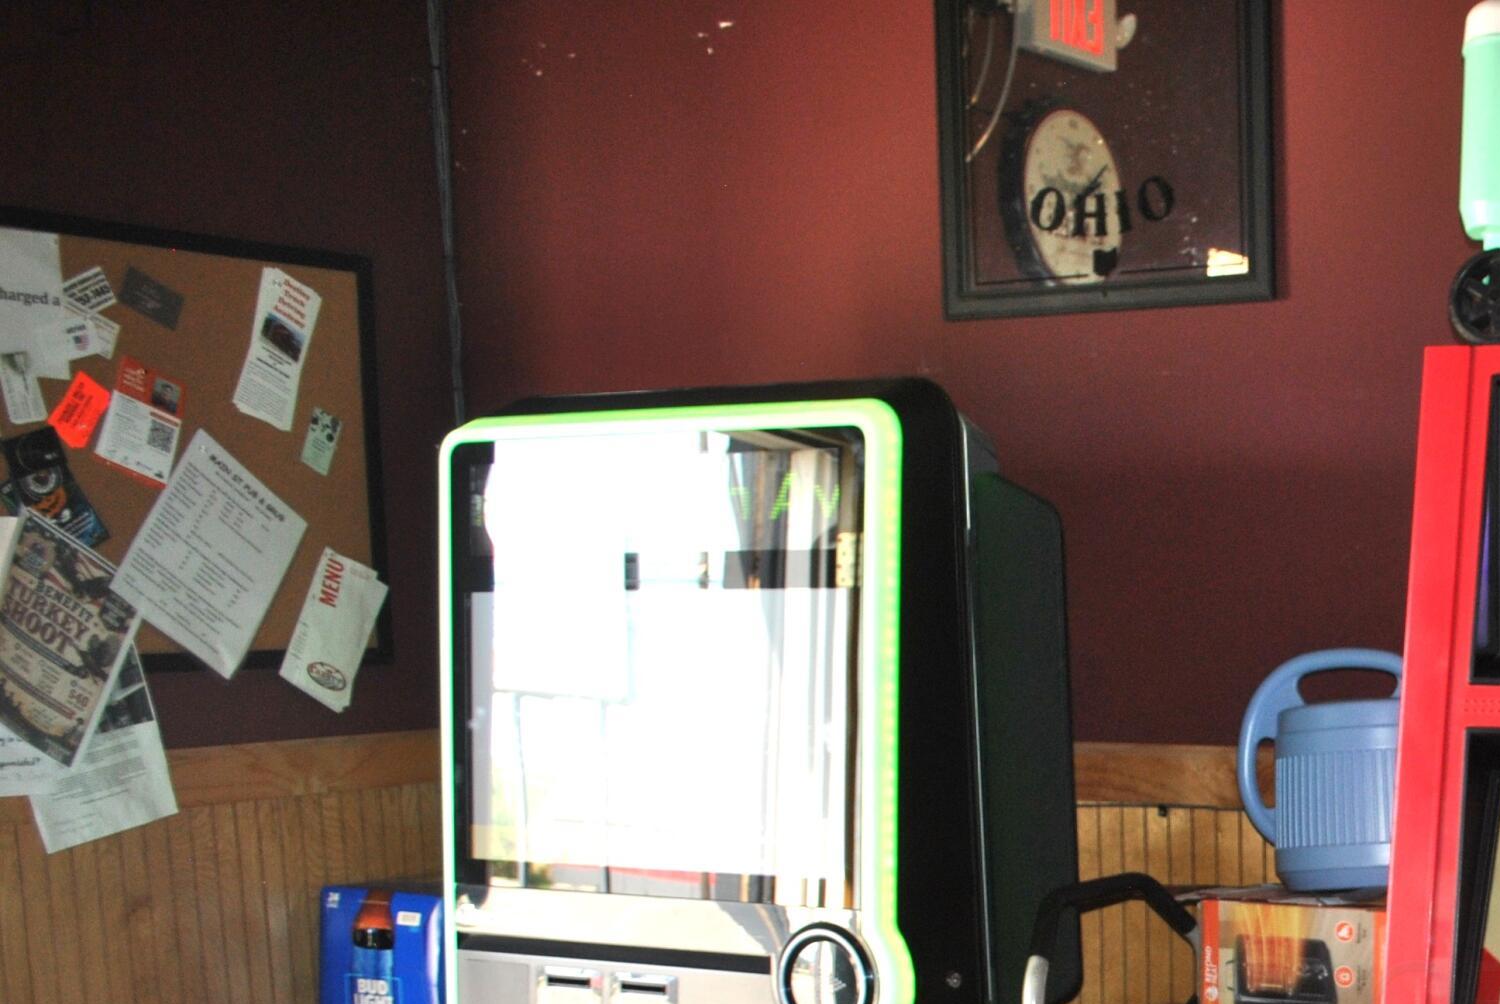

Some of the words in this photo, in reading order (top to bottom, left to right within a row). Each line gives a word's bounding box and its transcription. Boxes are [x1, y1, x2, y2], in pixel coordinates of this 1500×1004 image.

[1030, 168, 1175, 237] OHIO
[10, 576, 90, 640] TURKEY
[36, 581, 93, 623] BENEFIT
[319, 558, 345, 608] MENU
[357, 978, 389, 995] BUD
